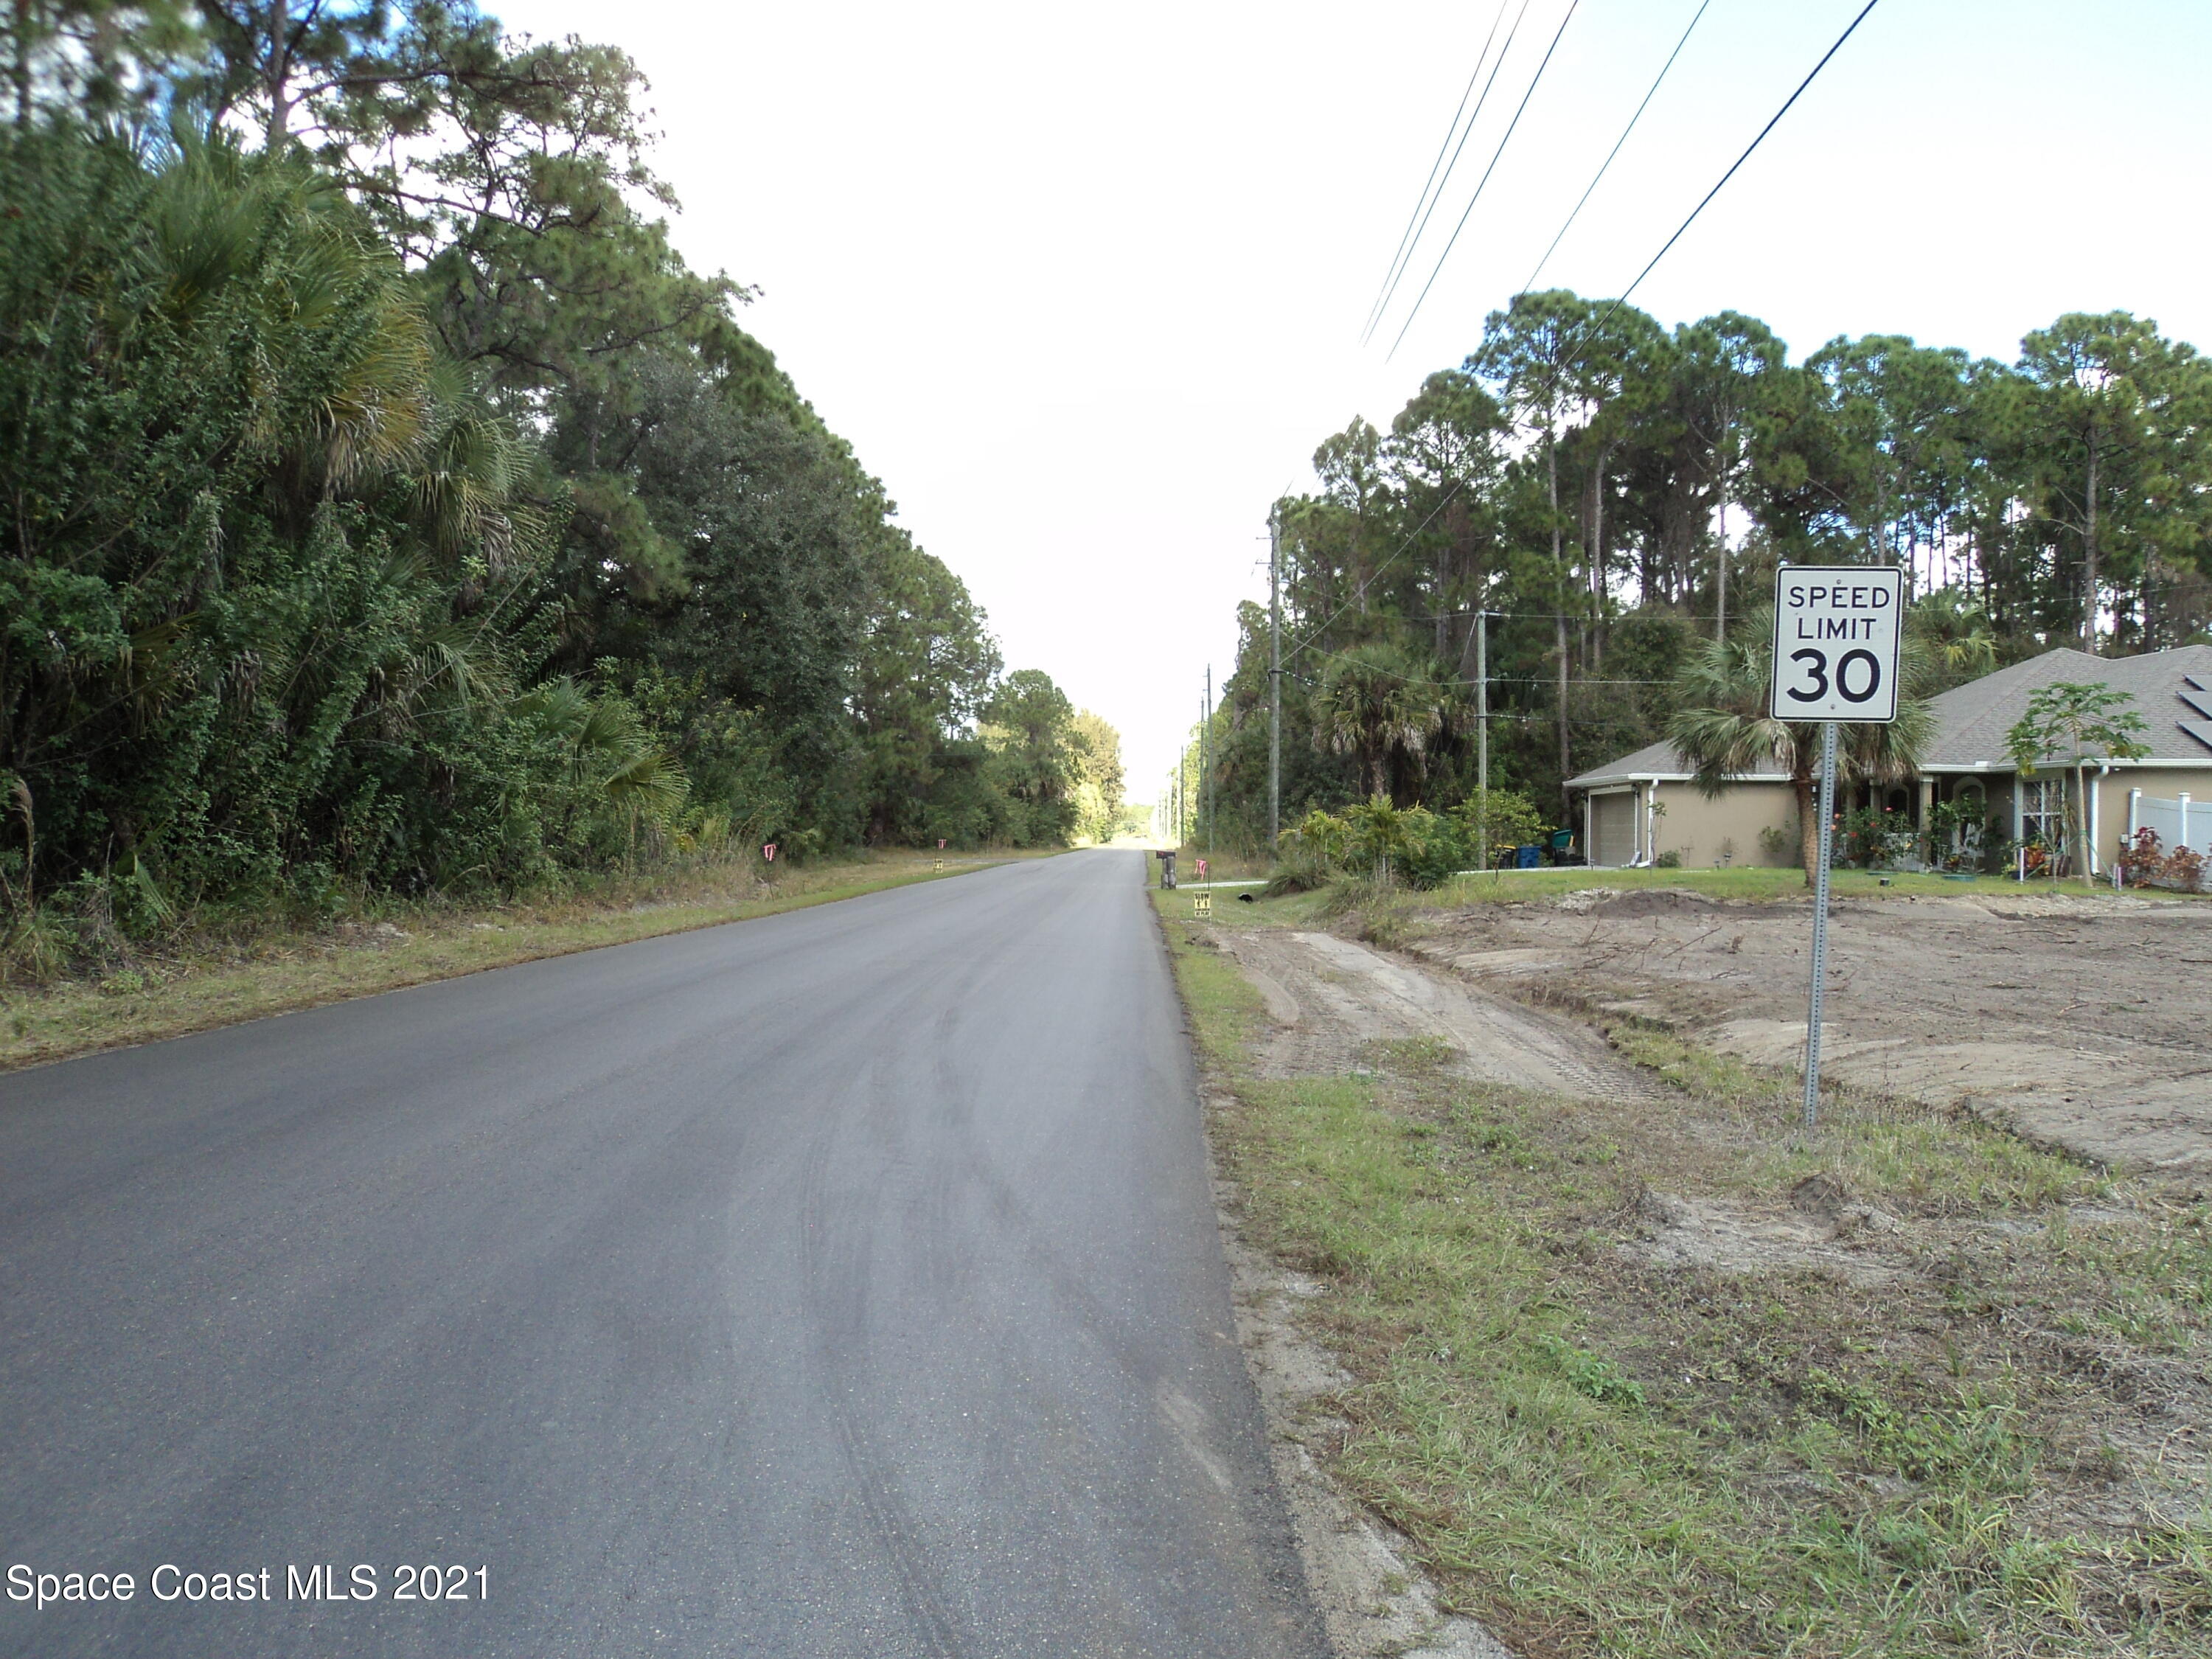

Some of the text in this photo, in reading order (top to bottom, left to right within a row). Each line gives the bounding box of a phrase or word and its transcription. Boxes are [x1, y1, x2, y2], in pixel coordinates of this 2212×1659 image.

[1788, 586, 1890, 608] SPEED
[1798, 618, 1877, 639] LIMIT
[1787, 648, 1881, 703] 30
